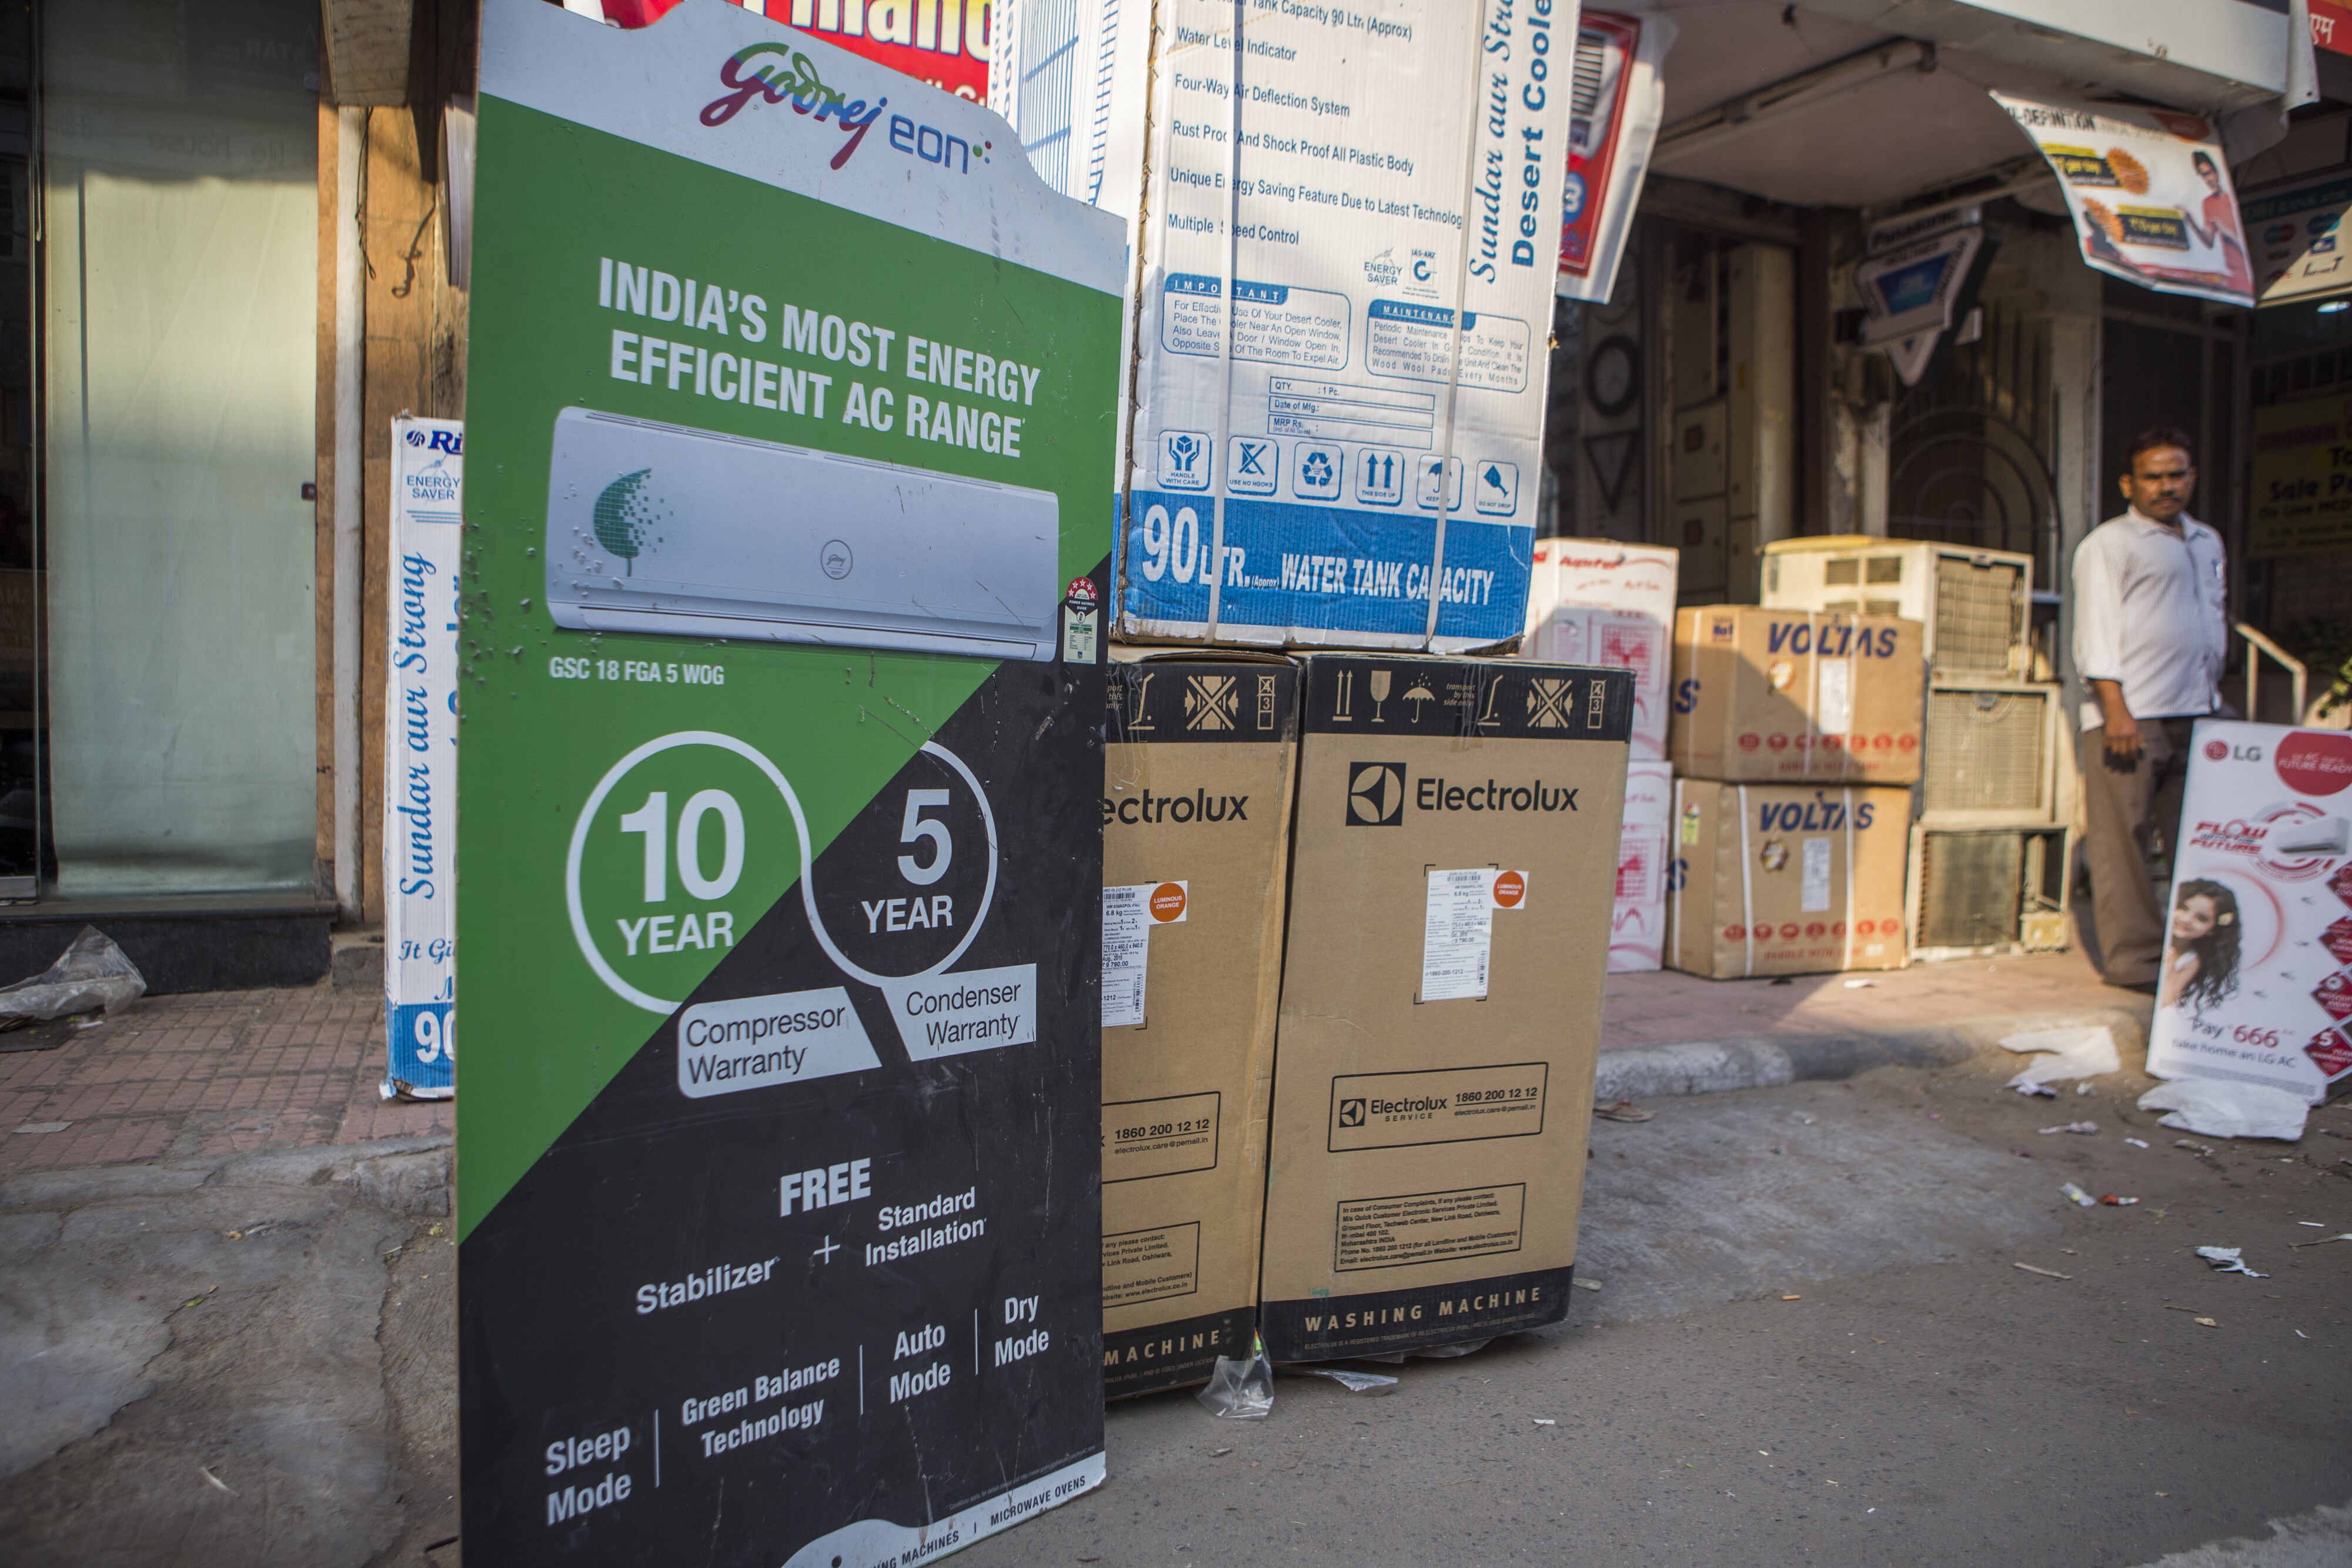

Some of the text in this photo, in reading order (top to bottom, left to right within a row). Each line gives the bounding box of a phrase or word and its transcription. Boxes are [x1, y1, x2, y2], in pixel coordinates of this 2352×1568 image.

[1253, 0, 1278, 12] Tank
[1281, 0, 1328, 25] Capacity
[1332, 9, 1344, 25] 90
[1367, 16, 1412, 43] (Approx)
[1178, 26, 1210, 46] Water
[1248, 39, 1297, 62] Indicator
[700, 42, 888, 170] Godrej
[889, 115, 969, 175] eon
[1175, 74, 1350, 118] Four-Way Air Deflection System
[1173, 121, 1414, 176] Rust Proo And Shock Proof All Plastic Body
[1511, 0, 1552, 268] Desert Coole
[1469, 73, 1508, 285] Sundar aur
[1171, 168, 1211, 189] Unique
[1258, 180, 1295, 202] Saving
[1299, 186, 1338, 205] Feature
[1341, 193, 1361, 209] Due
[1365, 198, 1375, 212] to
[1378, 199, 1410, 218] Latest
[1412, 205, 1462, 229] Technolog
[1168, 214, 1214, 235] Multiple
[1259, 225, 1299, 245] Control
[1364, 262, 1403, 276] ENERGY
[1368, 273, 1397, 286] SAVER
[1175, 280, 1278, 300] IMPOTANT
[599, 256, 1040, 406] INDIA'S MOST ENERGY
[1232, 307, 1341, 329] Use Of Your Desert Cooler,
[1383, 306, 1454, 322] MAINTENANC
[611, 329, 833, 419] EFFICIENT
[842, 382, 894, 432] AC
[1275, 383, 1339, 396] QTY. Pc.
[1275, 400, 1290, 409] Date
[1274, 418, 1304, 428] MRP Rs.
[407, 475, 460, 488] ENERGY
[412, 487, 455, 500] SAVER
[1142, 504, 1494, 606] 90 LTR. (Approx) WATER TANK CAACITY
[1768, 622, 1897, 658] VOLTAS
[550, 657, 594, 680] GSC
[596, 660, 620, 681] 18
[624, 661, 662, 684] FGA
[666, 665, 679, 684] 5
[393, 551, 436, 900] Sundar aur Strong
[2233, 745, 2261, 761] LG
[2278, 758, 2317, 771] FUTURE
[1102, 788, 1250, 825] ectrolux
[1416, 778, 1579, 812] Electrolux
[1759, 803, 1875, 832] VOLTAS
[2195, 820, 2268, 838] FLOW
[620, 788, 745, 902] 10
[897, 788, 953, 885] 5
[2190, 838, 2262, 854] FUTURE
[861, 895, 953, 933] YEAR
[616, 911, 734, 955] YEAR
[905, 983, 1021, 1017] Condenser
[686, 1007, 846, 1056] Compressor
[926, 1014, 1018, 1048] Warranty
[2191, 1019, 2279, 1048] Pay 666
[687, 1045, 806, 1085] Warranty
[2200, 1043, 2296, 1068] home LG AC
[1371, 1096, 1447, 1115] Electrolux
[1455, 1087, 1538, 1103] 1860 200 12 12
[1115, 1119, 1209, 1139] 1860 200 12 12
[1385, 1113, 1433, 1122] SERVICE
[779, 1158, 871, 1218] FREE
[877, 1186, 975, 1232] Standard
[865, 1218, 985, 1267] Installation
[1118, 1239, 1138, 1247] please
[635, 1256, 777, 1316] Stabilizer
[1004, 1295, 1040, 1325] Dry
[1305, 1287, 1541, 1332] WASHING MACHINE
[893, 1323, 946, 1361] Auto
[995, 1329, 1049, 1368] Mode
[1104, 1330, 1220, 1366] MACHINE
[682, 1358, 840, 1427] Green Balance
[889, 1363, 951, 1405] Mode
[701, 1399, 824, 1457] Technology
[545, 1425, 630, 1476] Sleep
[546, 1472, 632, 1526] Mode
[902, 1475, 1085, 1564] MACHINES MICROWAVE OVENS
